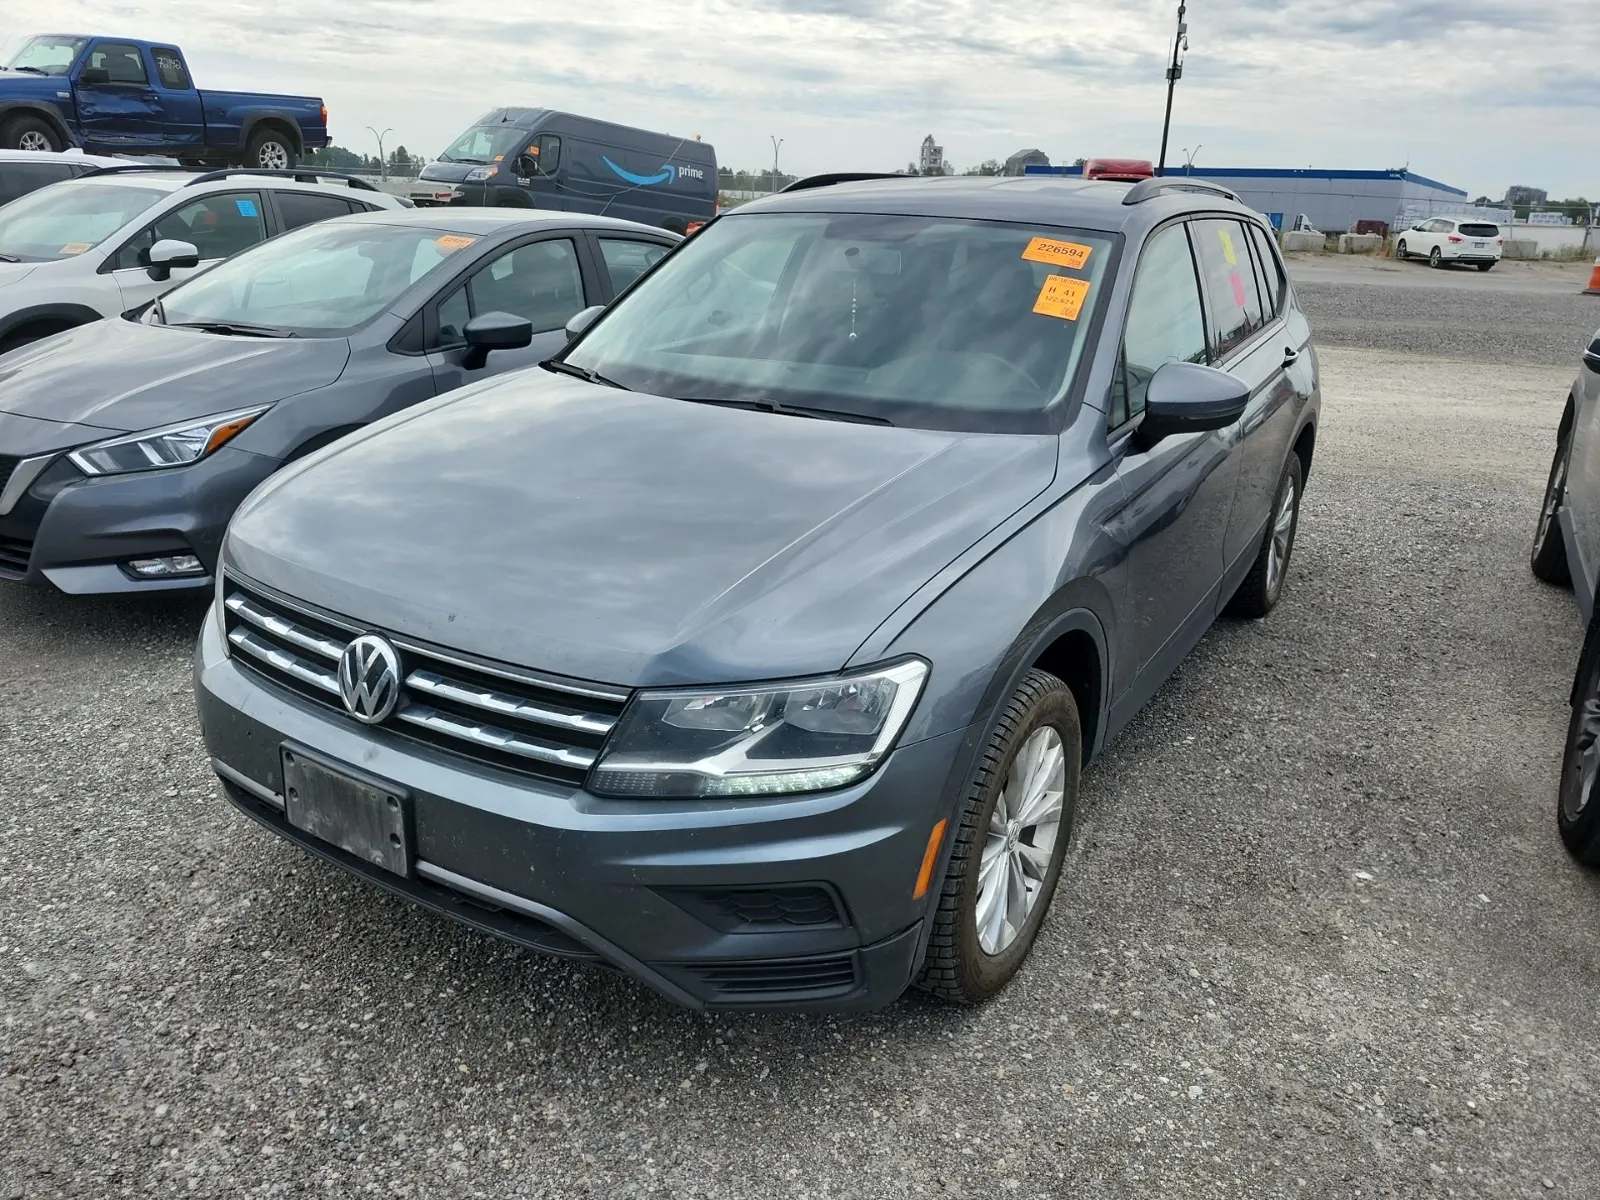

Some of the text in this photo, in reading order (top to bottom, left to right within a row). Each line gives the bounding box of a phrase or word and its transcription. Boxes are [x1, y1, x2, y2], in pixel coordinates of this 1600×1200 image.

[678, 165, 703, 179] prime
[1037, 243, 1084, 258] 226594
[1063, 289, 1075, 297] 41
